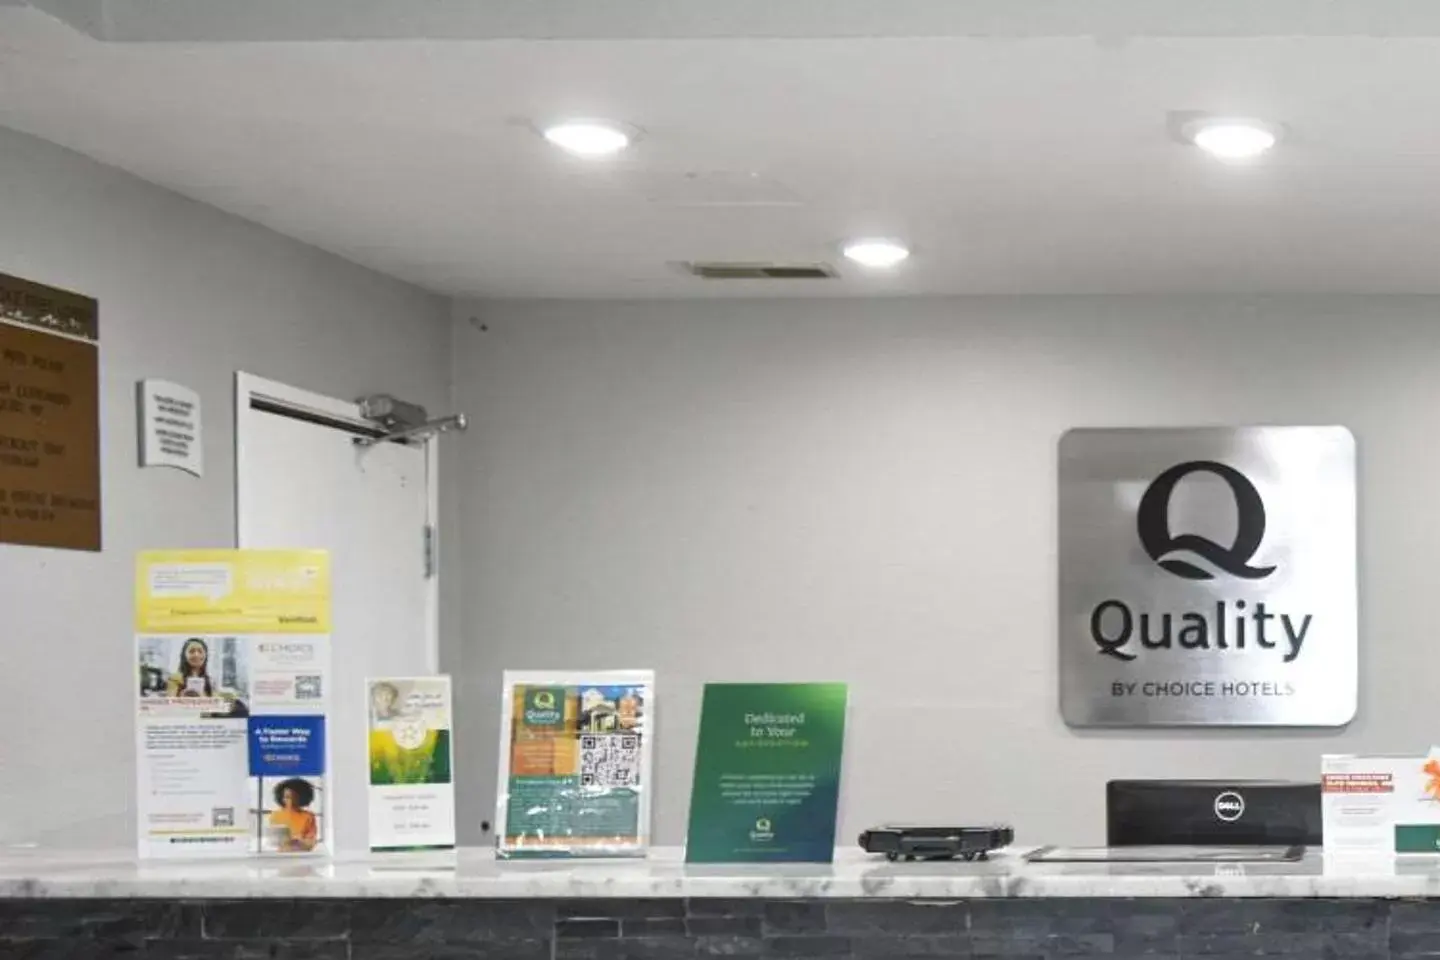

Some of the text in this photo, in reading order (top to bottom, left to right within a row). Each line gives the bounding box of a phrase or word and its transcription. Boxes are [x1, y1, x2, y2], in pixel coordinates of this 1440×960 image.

[1090, 599, 1312, 663] Quality
[1111, 682, 1296, 697] BY CHOICE HOTELS
[744, 711, 806, 725] Dedicated
[1218, 801, 1241, 811] DELL
